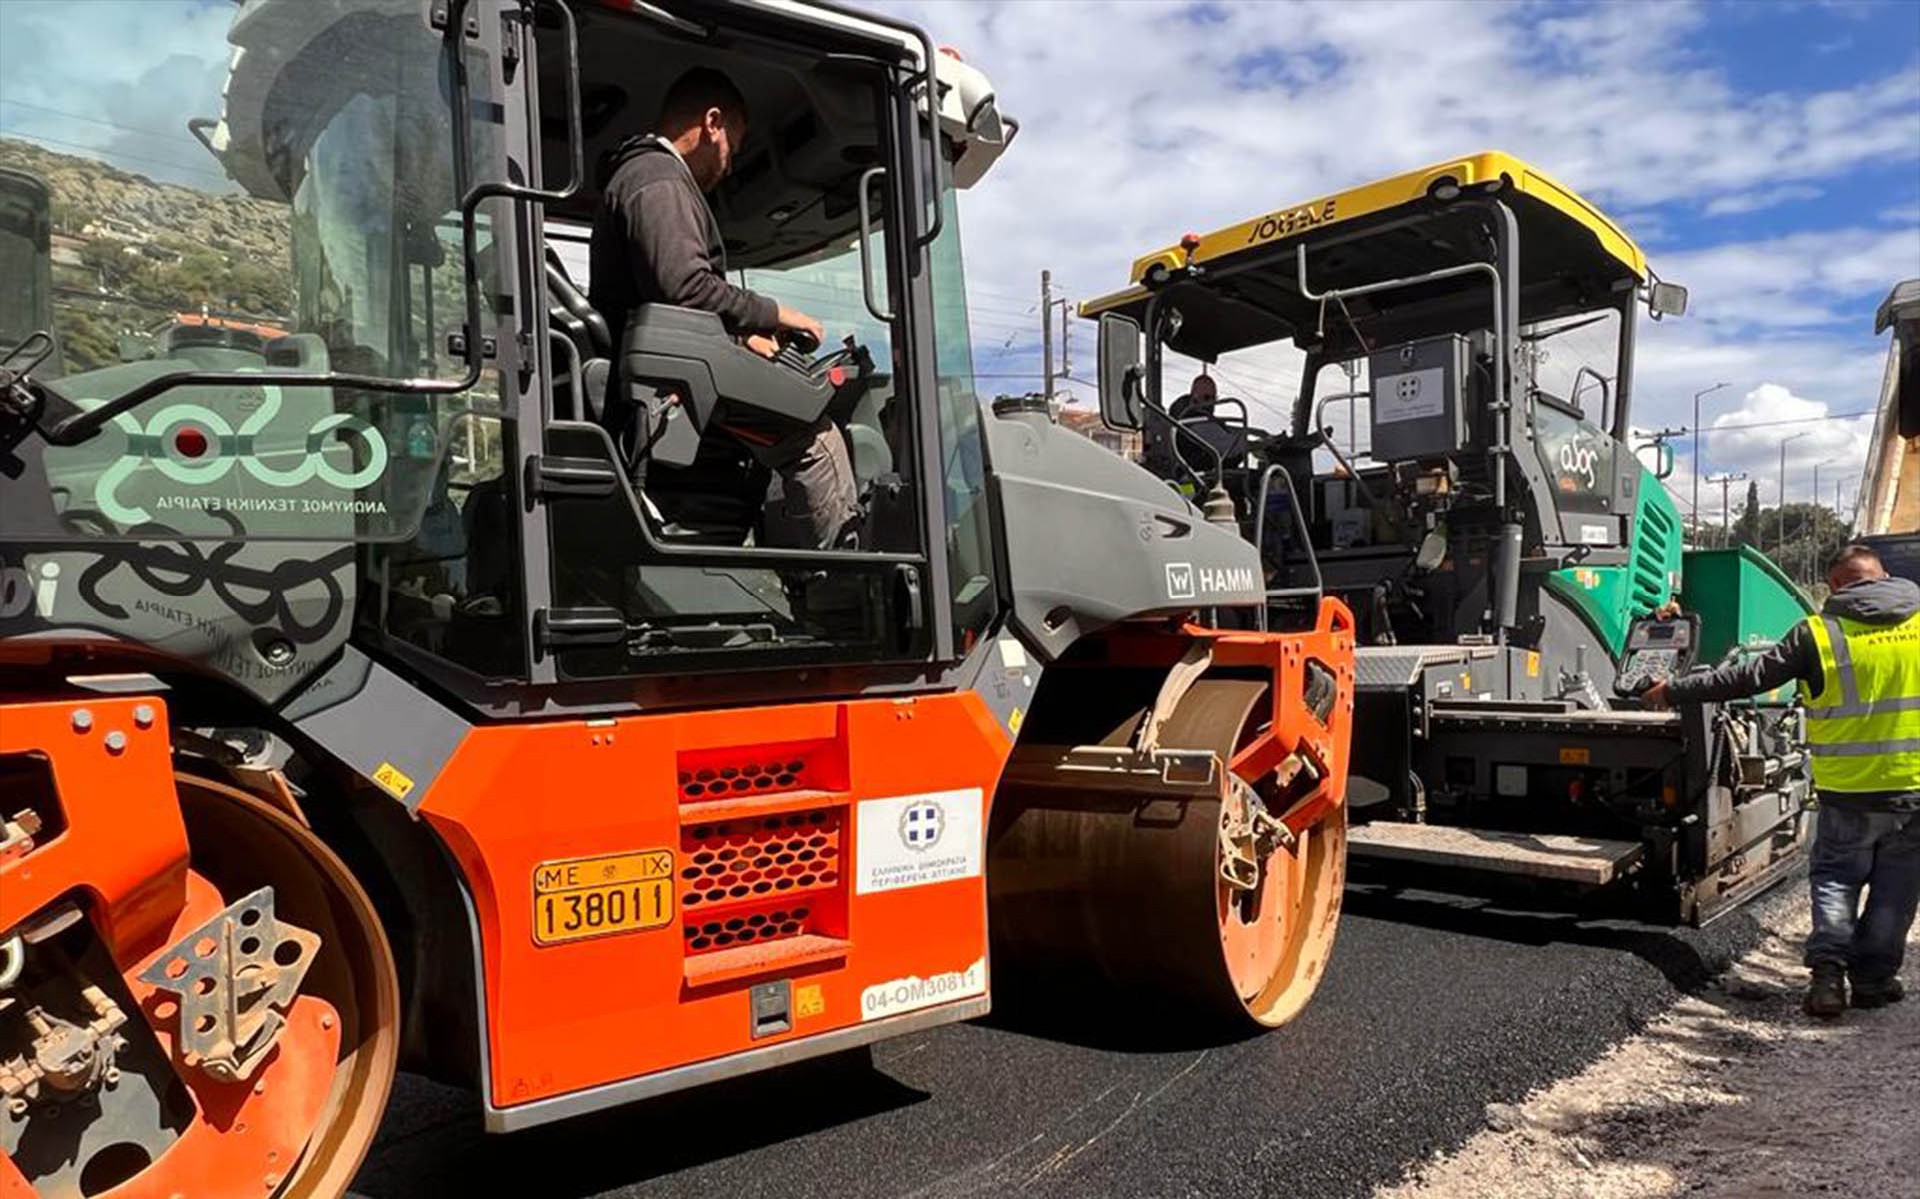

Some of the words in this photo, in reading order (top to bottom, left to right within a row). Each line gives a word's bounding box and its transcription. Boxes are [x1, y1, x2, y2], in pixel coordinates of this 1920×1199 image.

[1201, 568, 1254, 592] HAMM
[546, 884, 661, 934] 138011
[866, 969, 977, 1011] 04-OM30811
